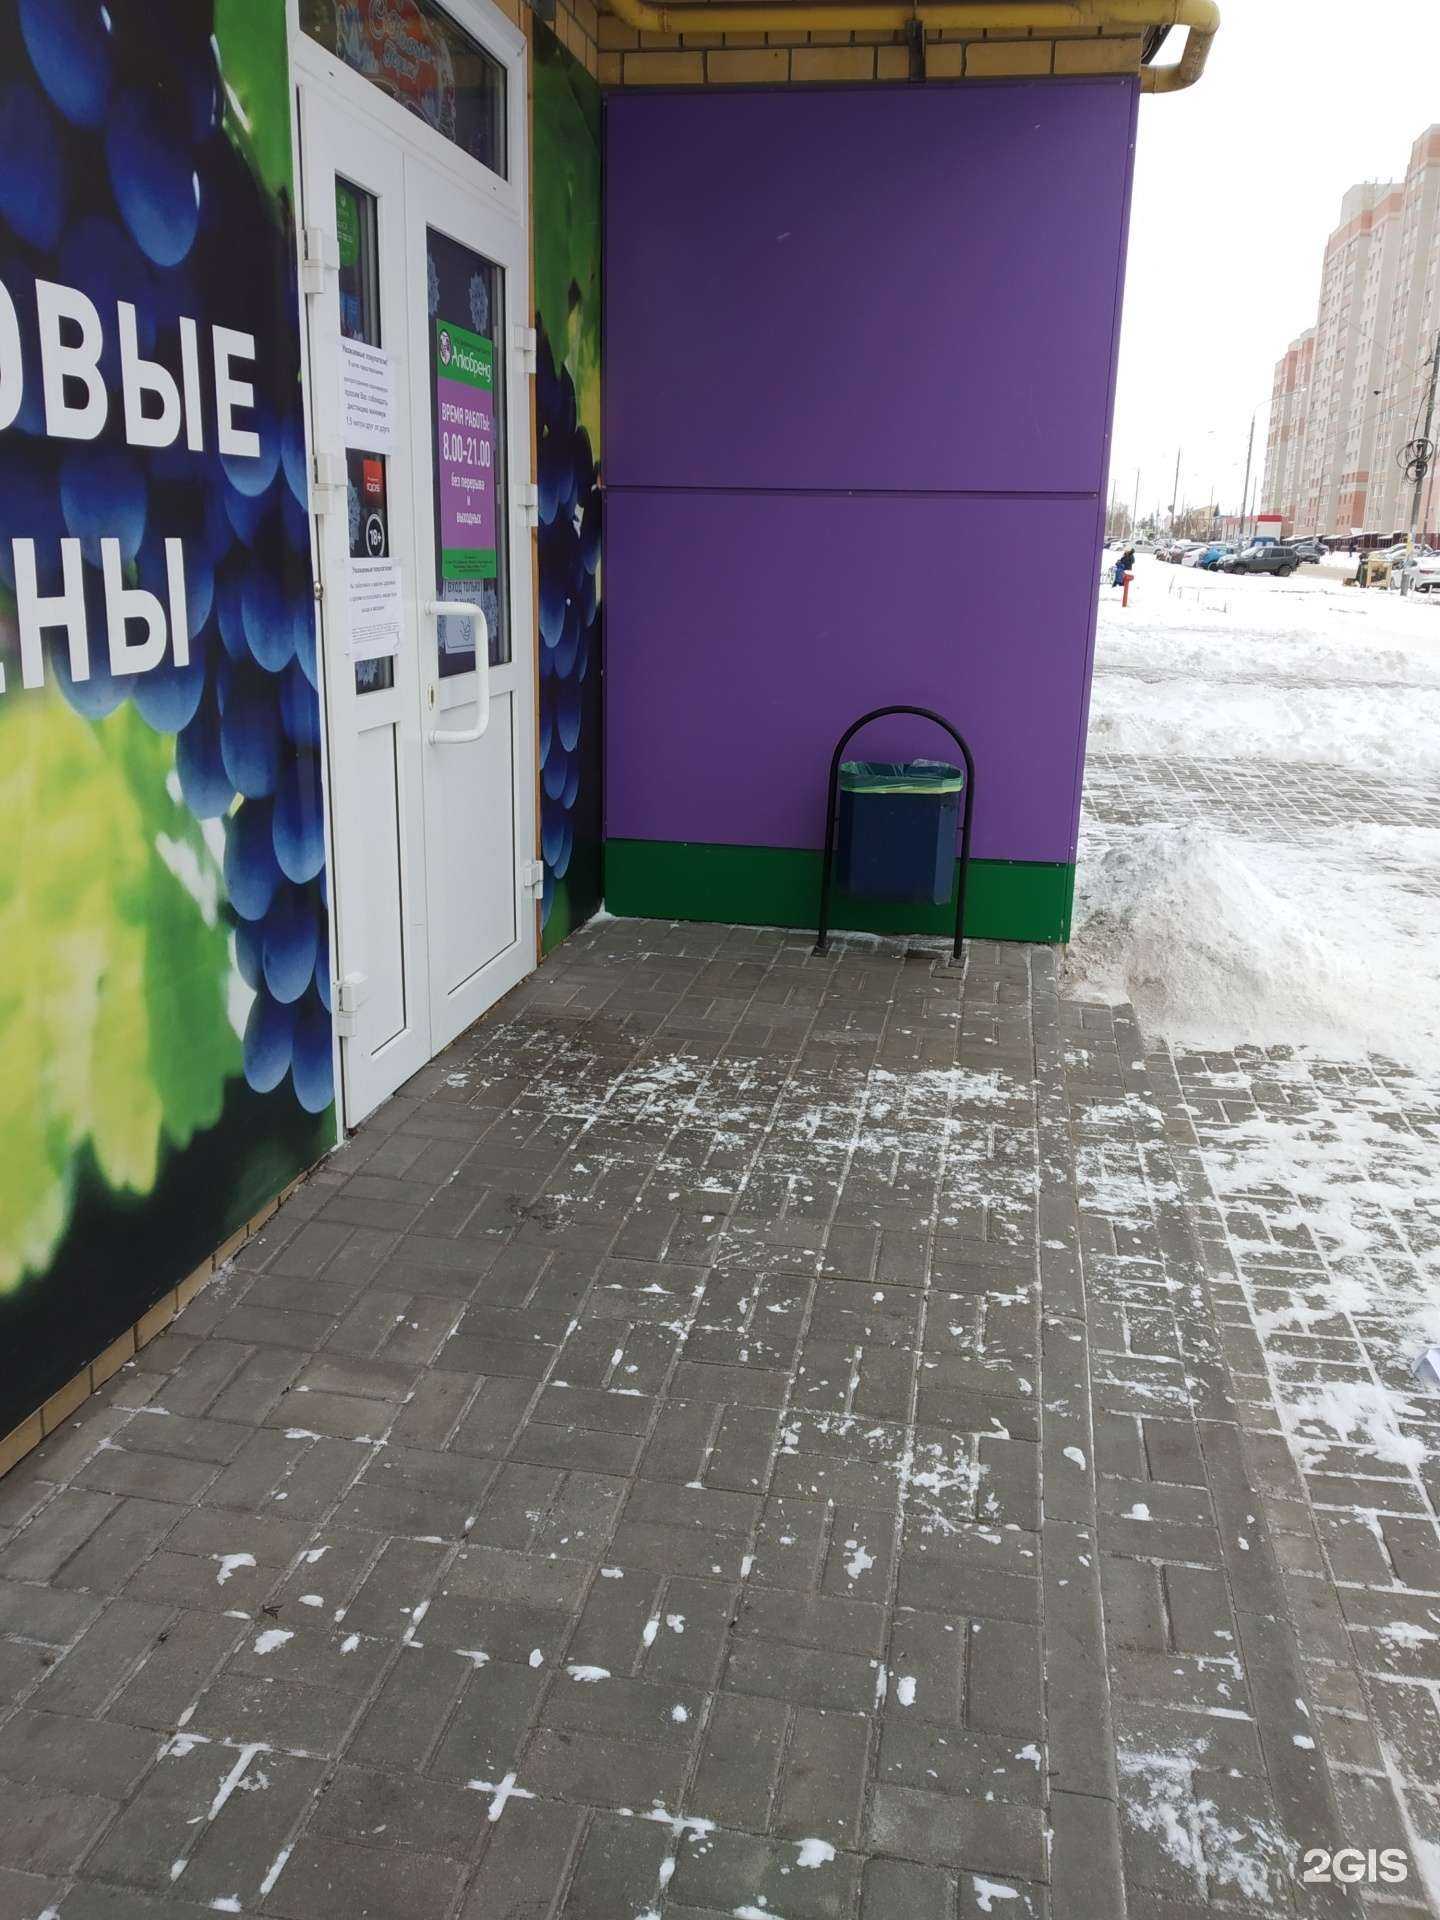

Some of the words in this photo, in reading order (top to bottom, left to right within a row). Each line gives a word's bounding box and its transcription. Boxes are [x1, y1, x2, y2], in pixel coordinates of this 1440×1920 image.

[0, 278, 261, 458] ВЫЕ
[451, 346, 492, 383] Алкобренд
[441, 402, 464, 425] ВРЕМЯ
[443, 431, 491, 468] 8.00-21.00
[451, 472, 460, 488] без
[460, 476, 485, 492] перерыва
[456, 511, 482, 525] выходных
[369, 529, 382, 546] 18+
[0, 537, 190, 694] НЫ
